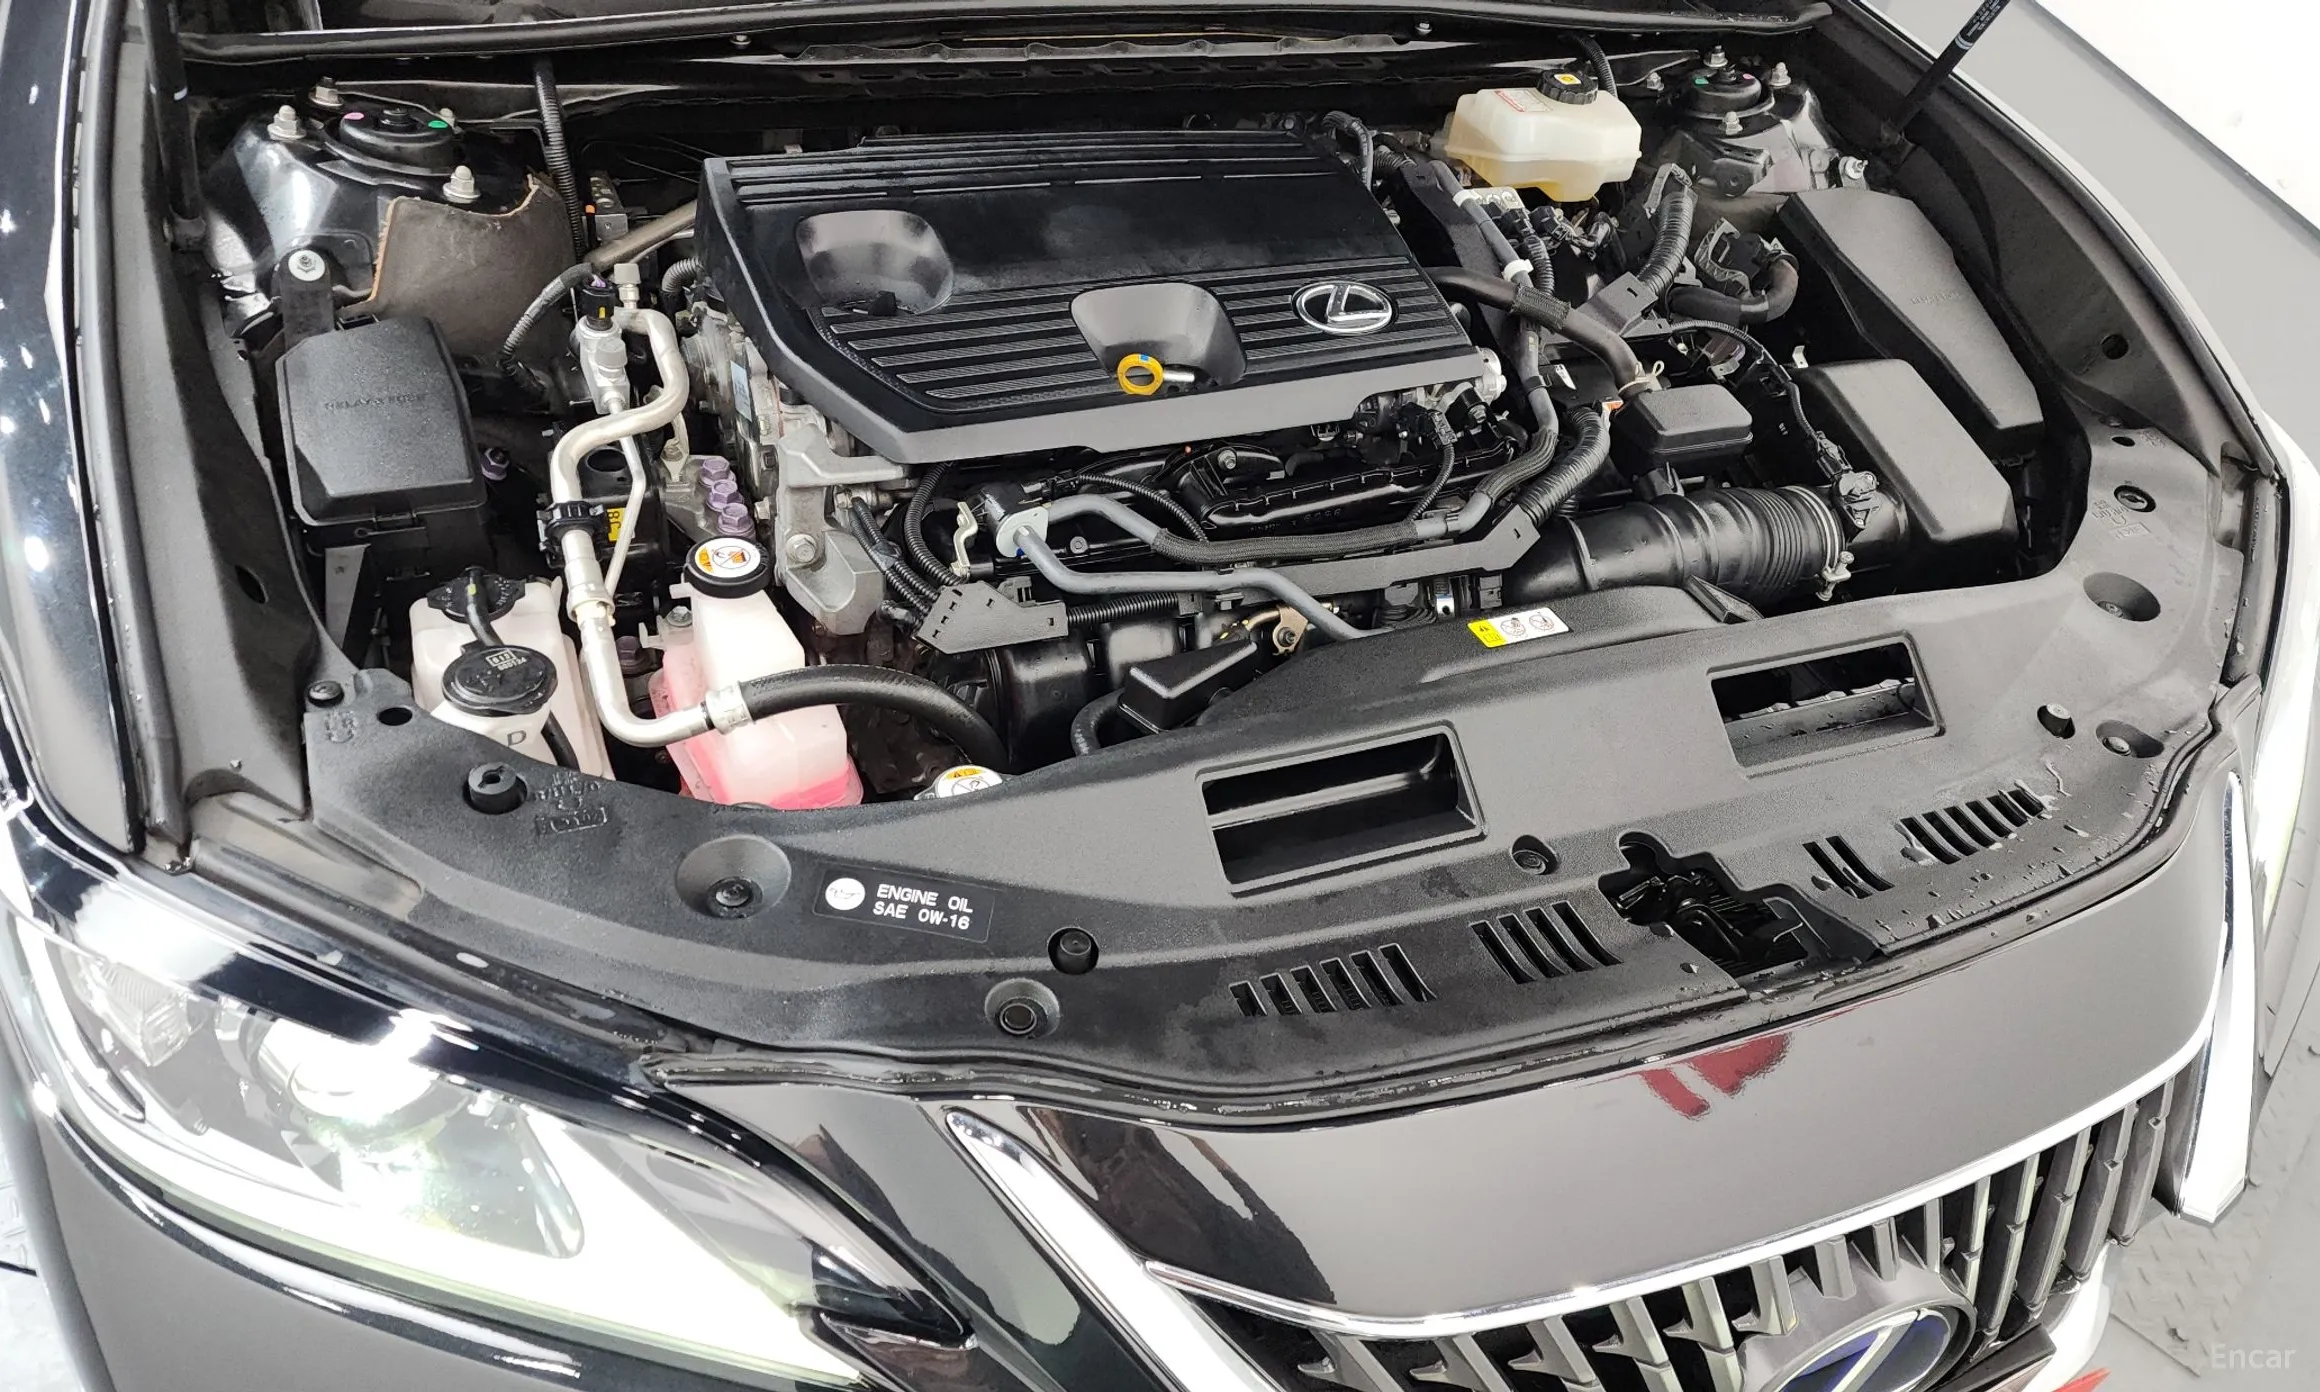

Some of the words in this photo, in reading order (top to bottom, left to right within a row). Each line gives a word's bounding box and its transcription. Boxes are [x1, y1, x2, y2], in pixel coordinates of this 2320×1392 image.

[876, 883, 939, 907] ENGINE
[948, 896, 974, 914] OIL
[873, 901, 909, 919] SAE
[918, 908, 970, 930] 0W-16
